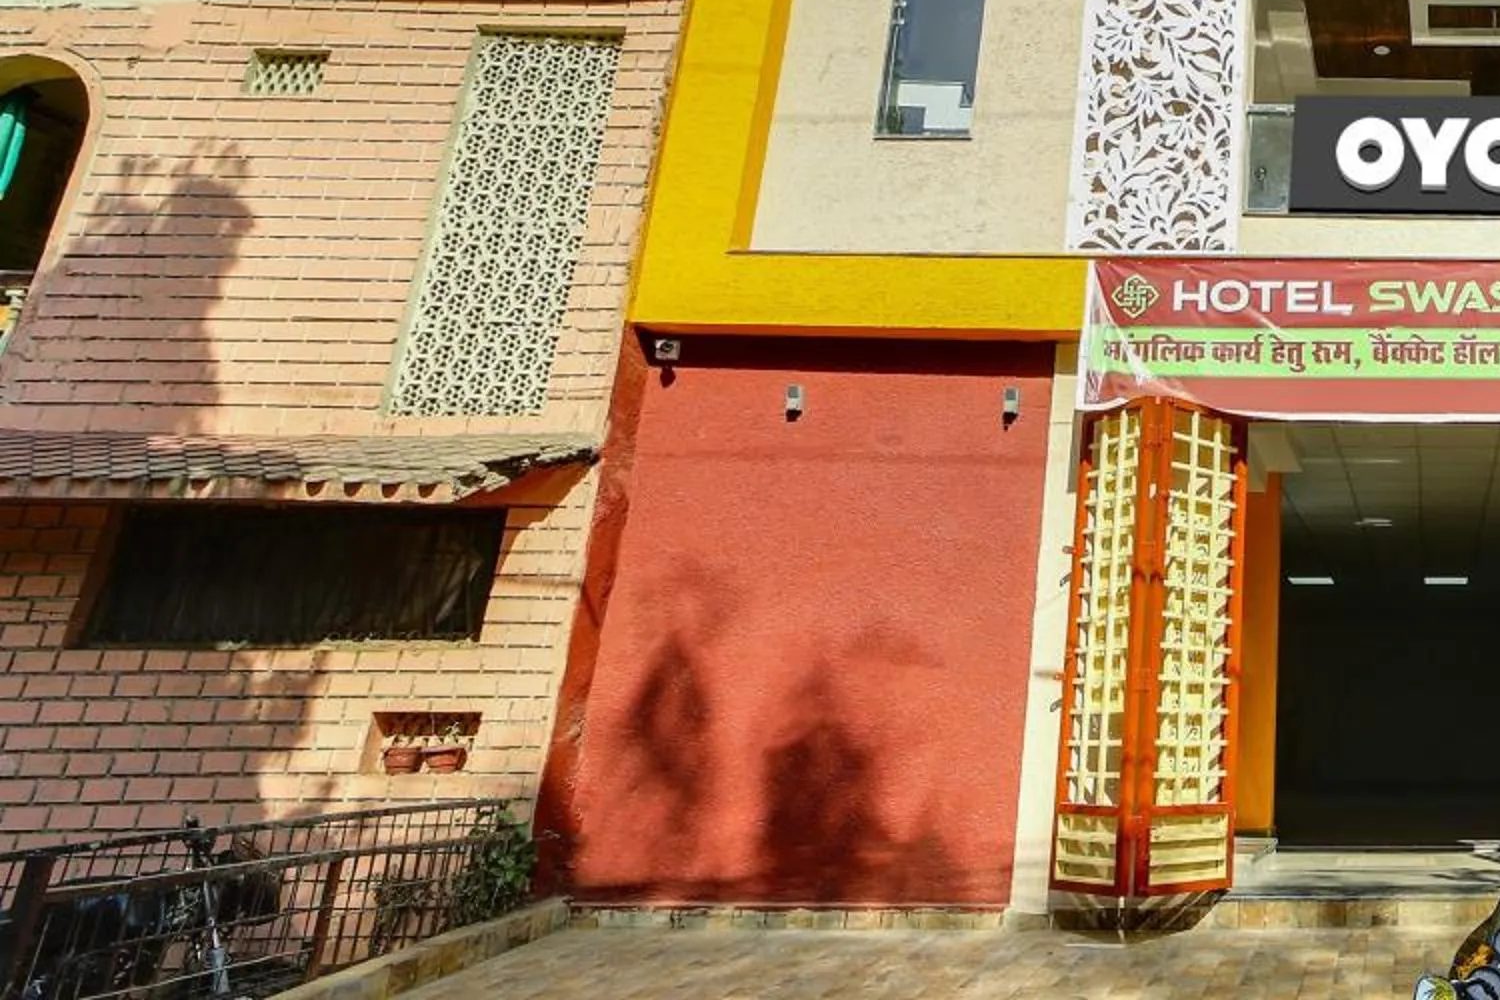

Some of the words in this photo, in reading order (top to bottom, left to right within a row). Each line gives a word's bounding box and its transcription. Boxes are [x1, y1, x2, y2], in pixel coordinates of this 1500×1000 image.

[1172, 278, 1355, 315] HOTEL
[1211, 333, 1264, 363] कार्य
[1269, 333, 1306, 372] हेतु
